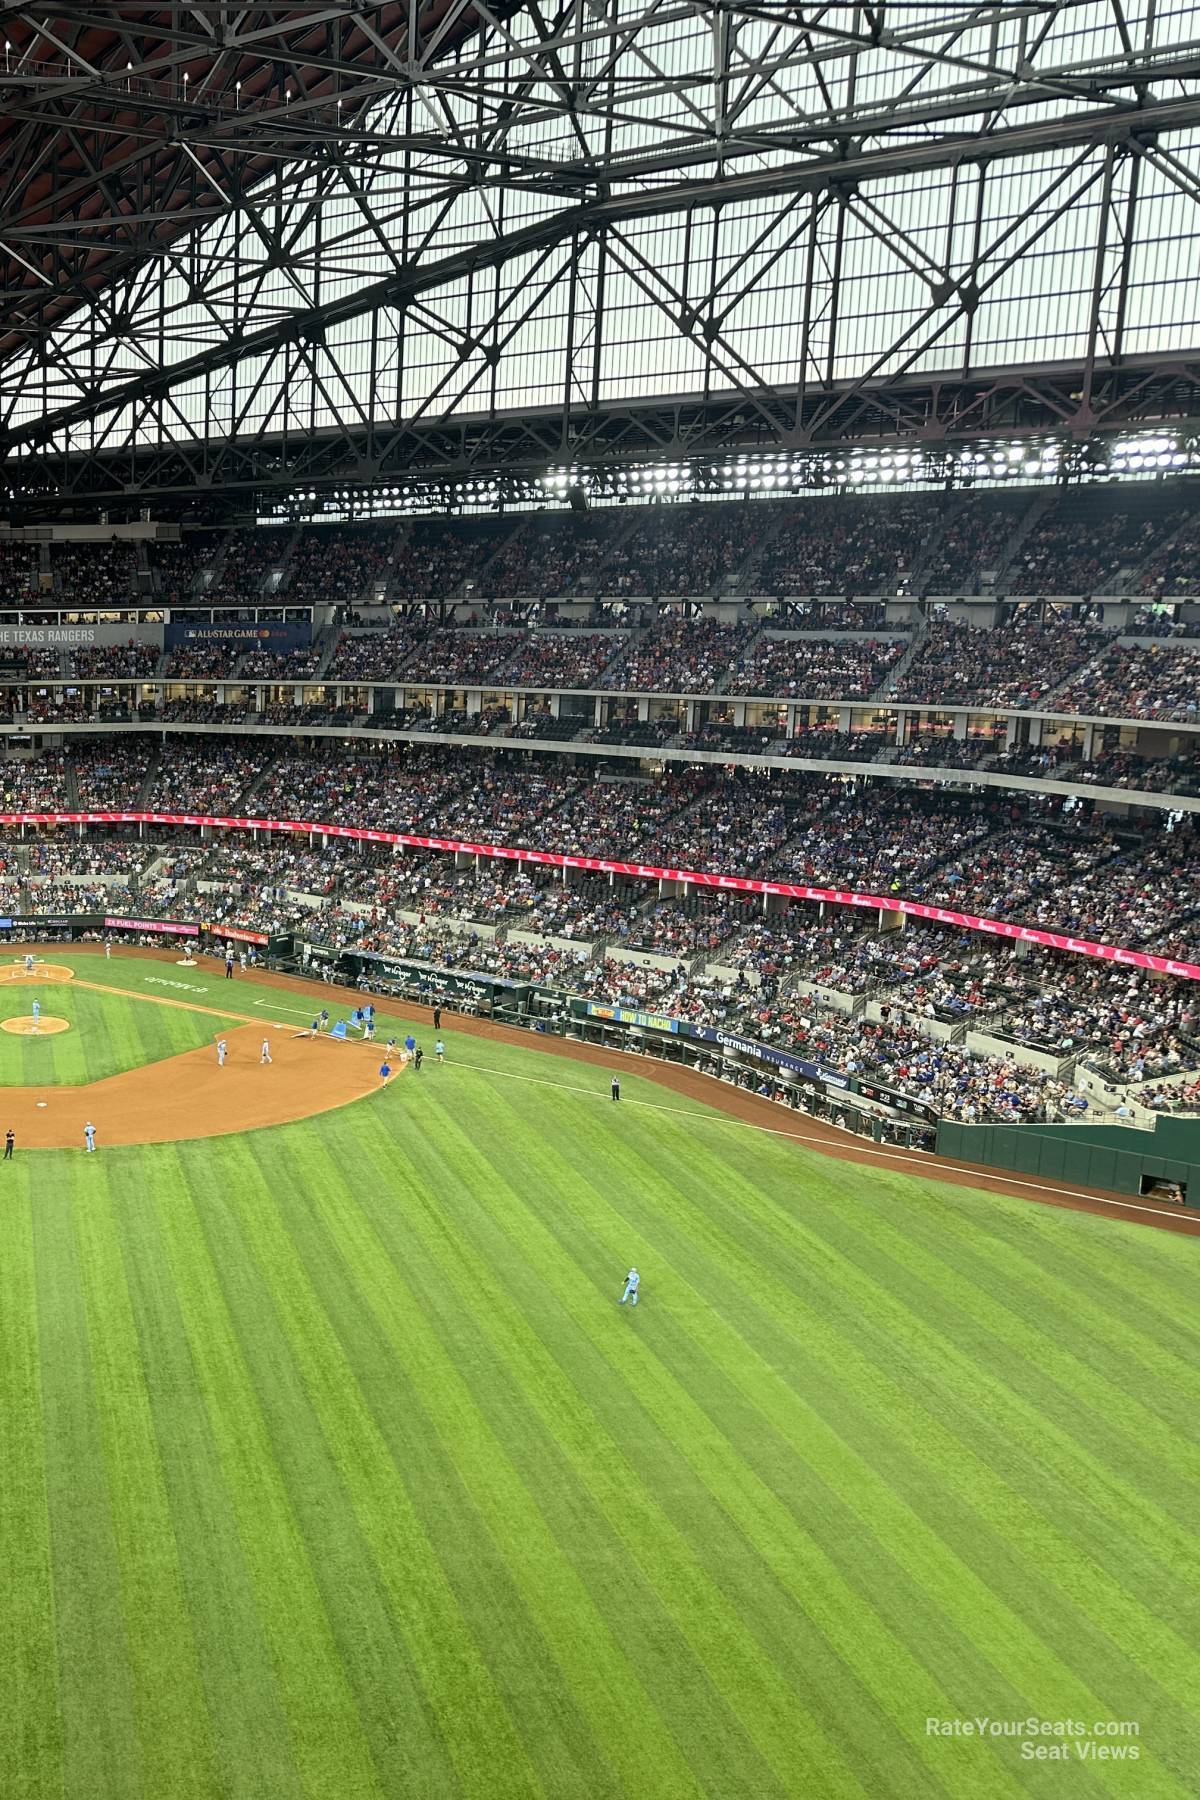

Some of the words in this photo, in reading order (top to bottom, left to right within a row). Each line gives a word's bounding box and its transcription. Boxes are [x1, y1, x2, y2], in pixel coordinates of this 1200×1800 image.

[13, 630, 45, 643] TEXAS
[47, 629, 95, 642] RANGERS
[234, 629, 258, 638] GAME
[134, 921, 157, 929] POINTS
[391, 966, 412, 980] Kroger
[427, 973, 449, 989] Kroger
[464, 981, 487, 997] Kroger
[620, 1010, 637, 1024] HOW
[638, 1014, 647, 1025] TO
[716, 1032, 762, 1058] Germania
[762, 1055, 804, 1073] INSURANCE
